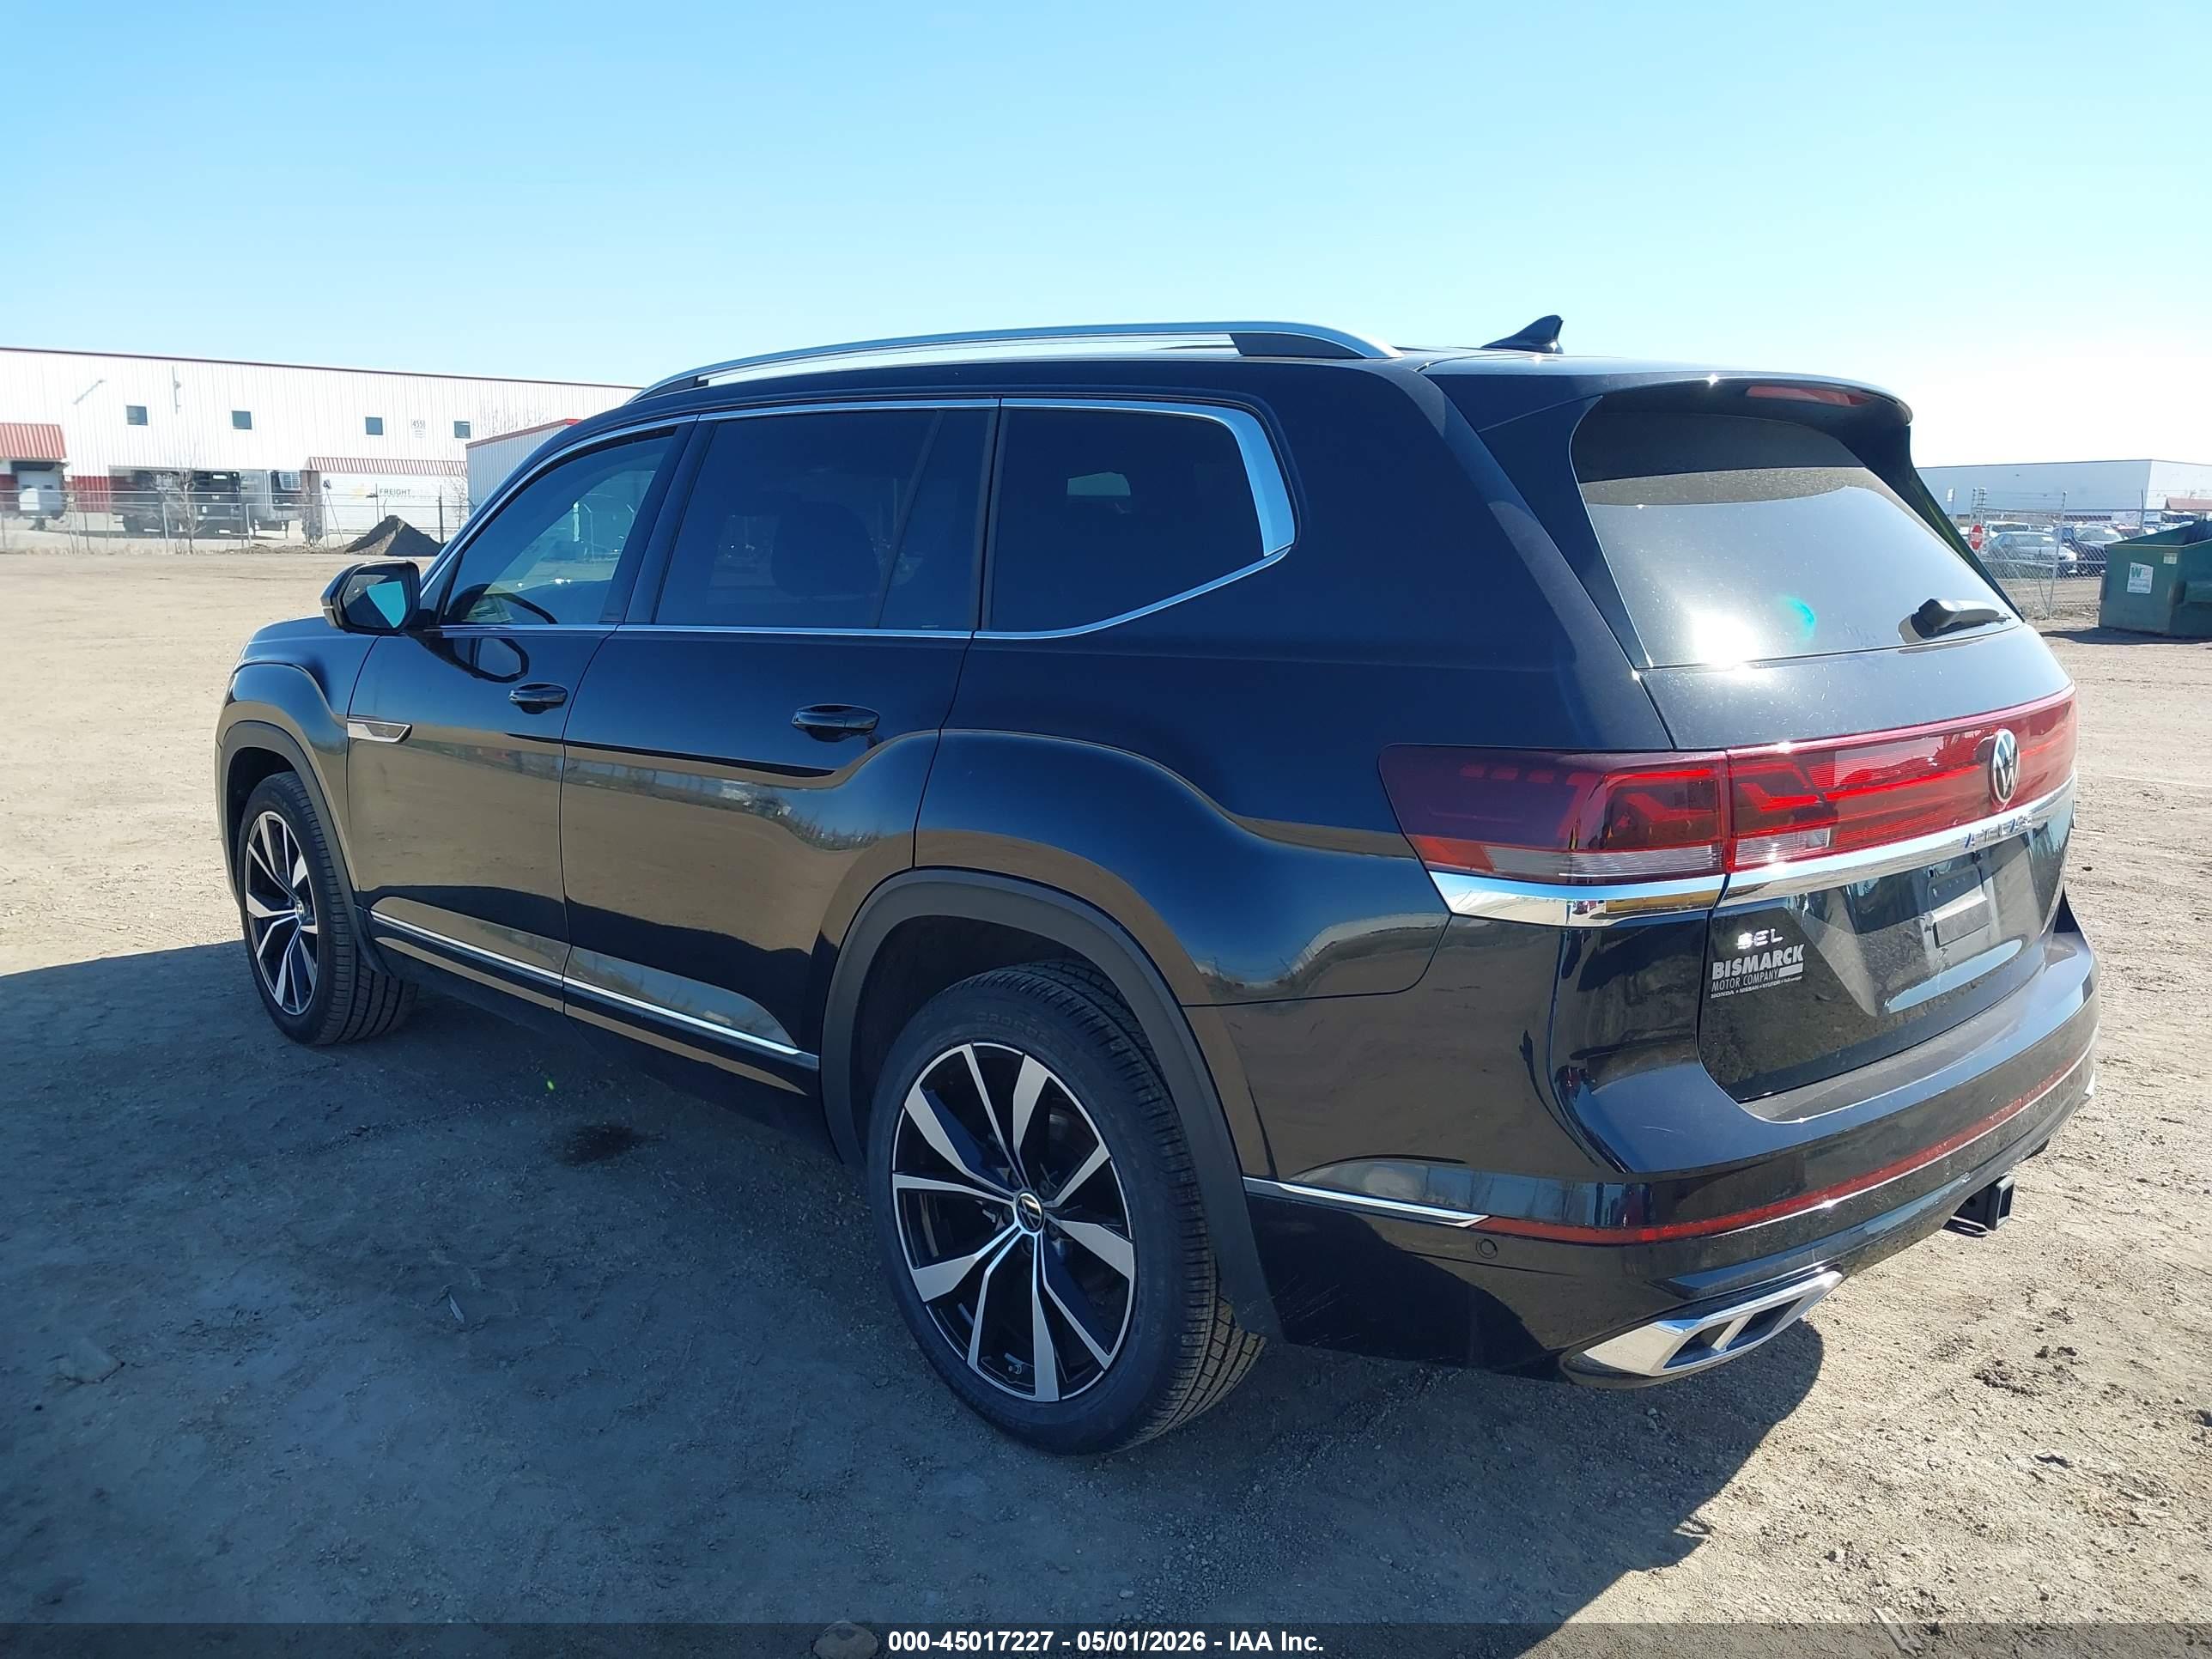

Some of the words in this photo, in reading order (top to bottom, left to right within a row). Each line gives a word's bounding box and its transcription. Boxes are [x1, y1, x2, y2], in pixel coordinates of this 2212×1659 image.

[1736, 928, 1784, 950] SEL
[1712, 944, 1804, 980] BISMARCK
[1711, 977, 1741, 993] MOTOR
[1743, 967, 1779, 986] COMPANY
[1711, 990, 1735, 999] HONDA
